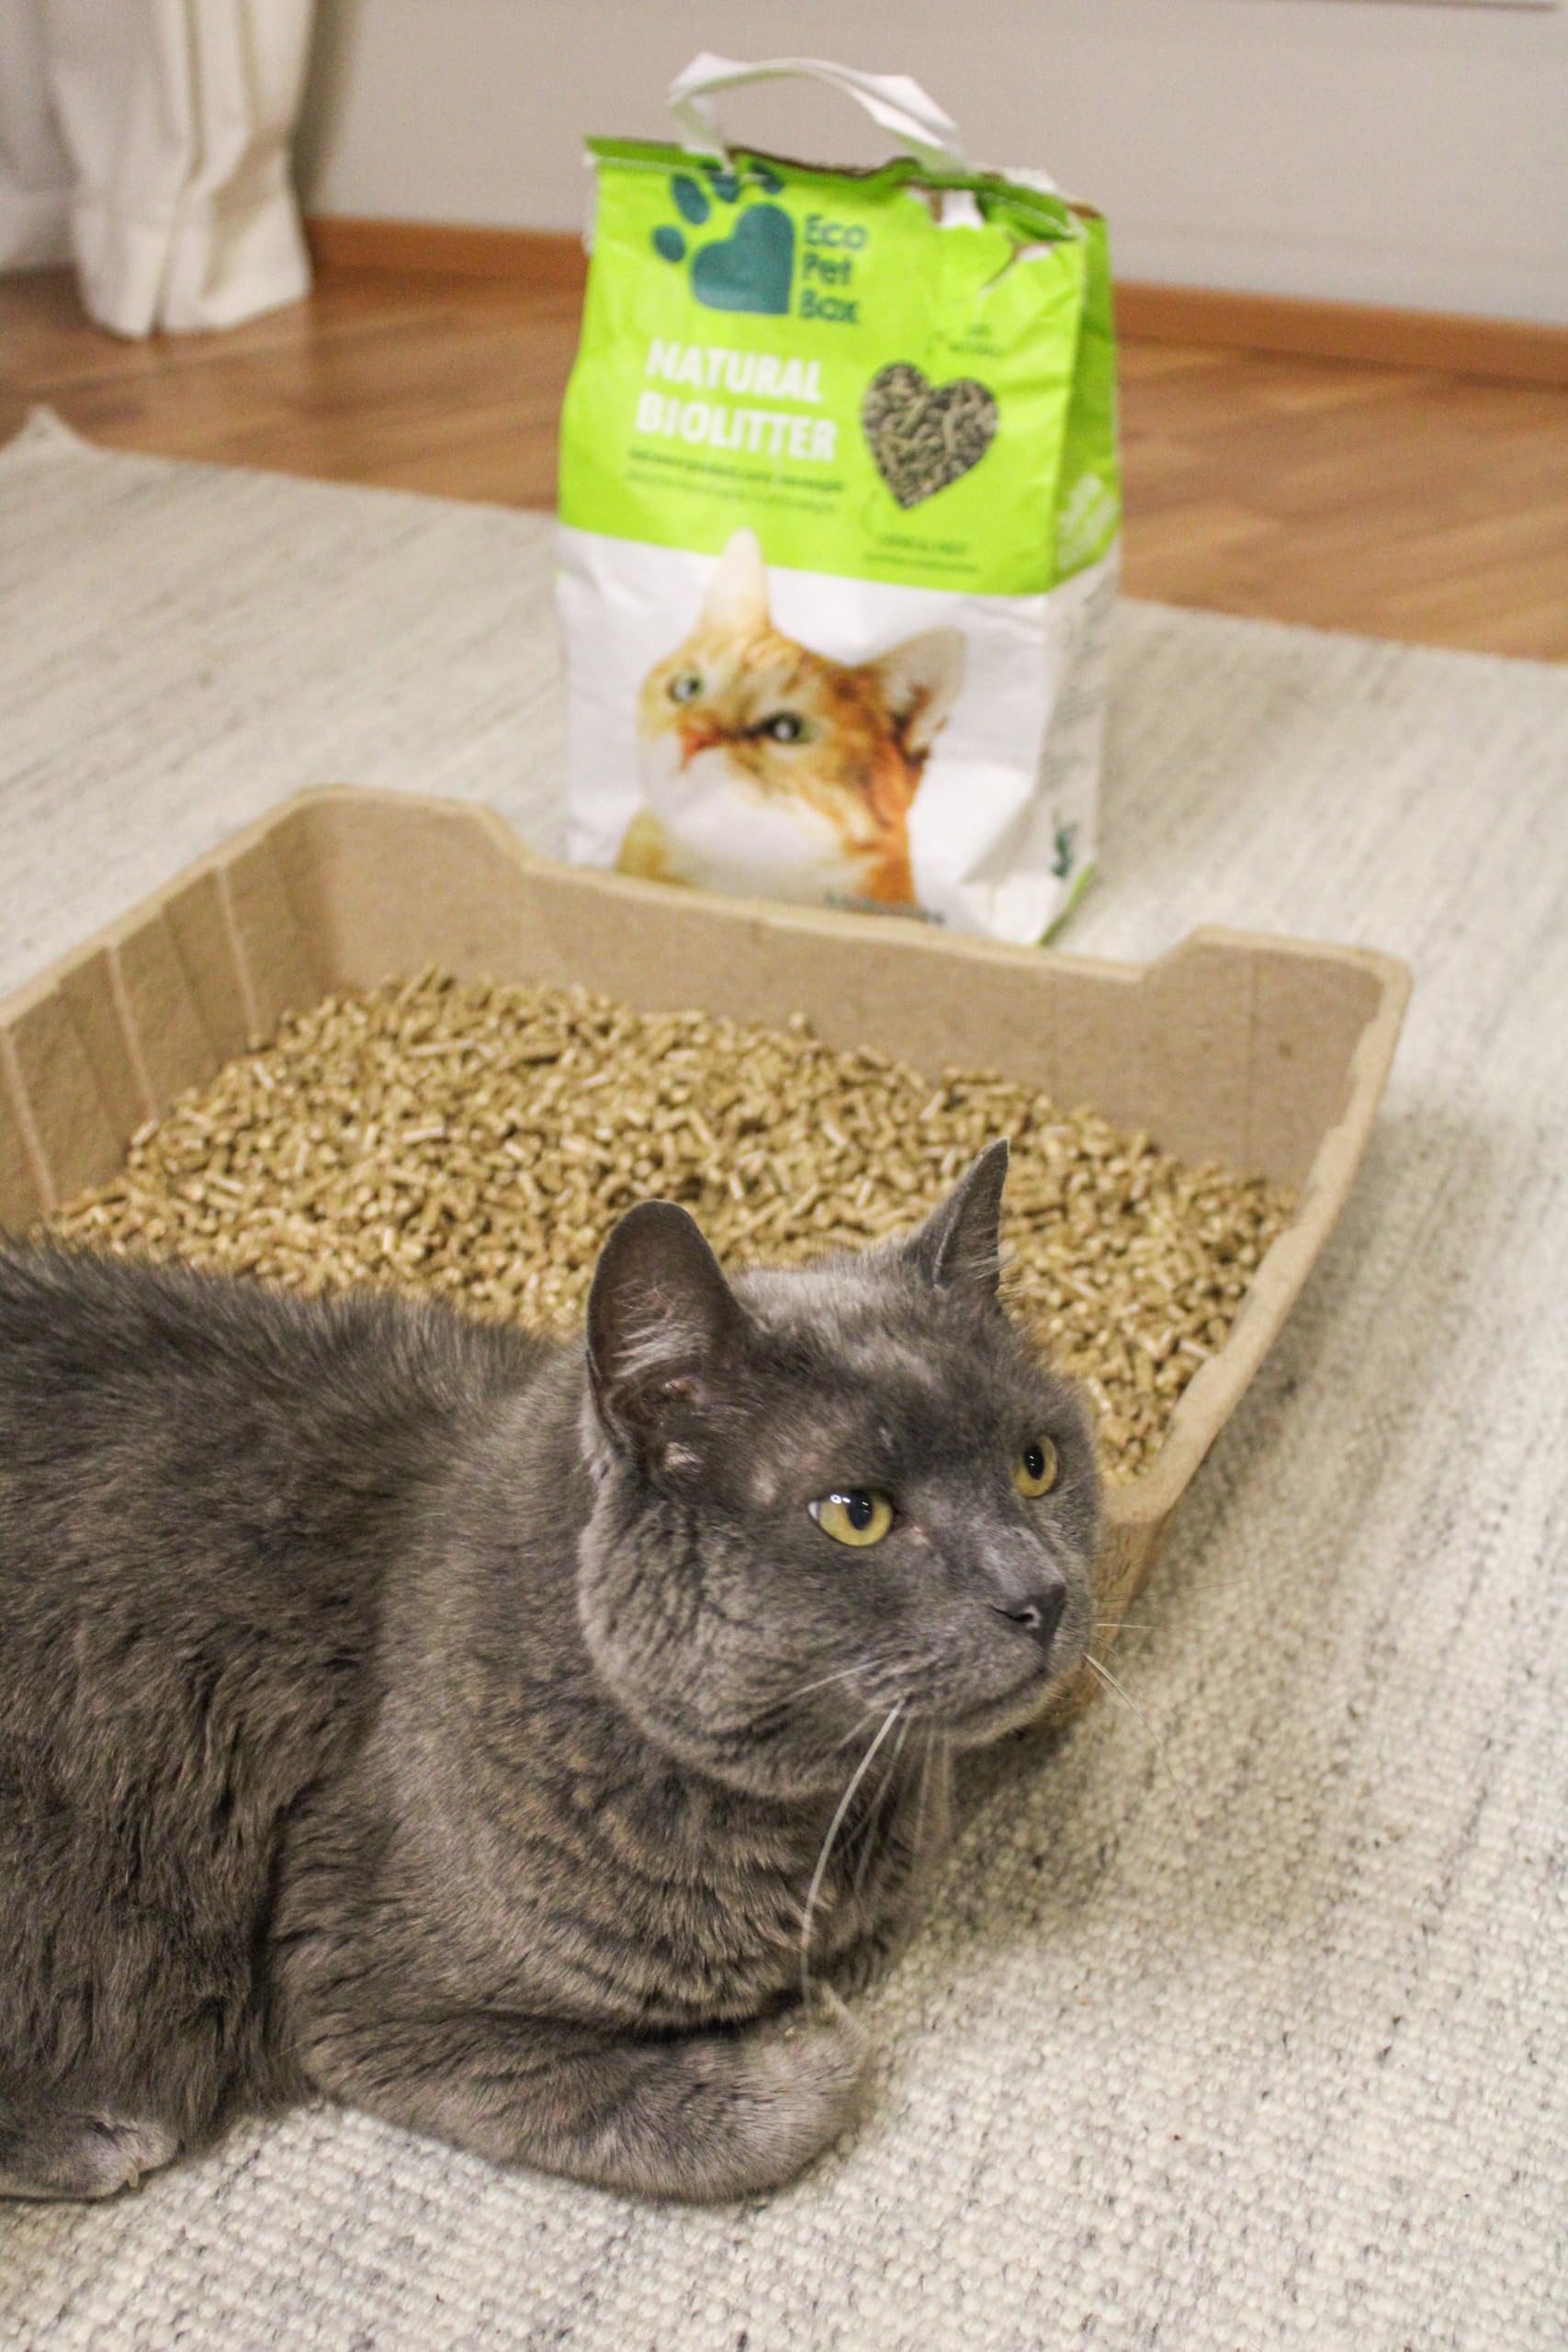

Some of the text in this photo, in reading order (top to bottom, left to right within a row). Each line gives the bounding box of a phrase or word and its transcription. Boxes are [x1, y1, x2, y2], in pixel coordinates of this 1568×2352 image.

[805, 214, 867, 250] Eco
[804, 252, 853, 287] Pet
[799, 289, 857, 324] Box
[645, 338, 822, 402] NATURAL
[636, 390, 838, 462] BIOLITTER
